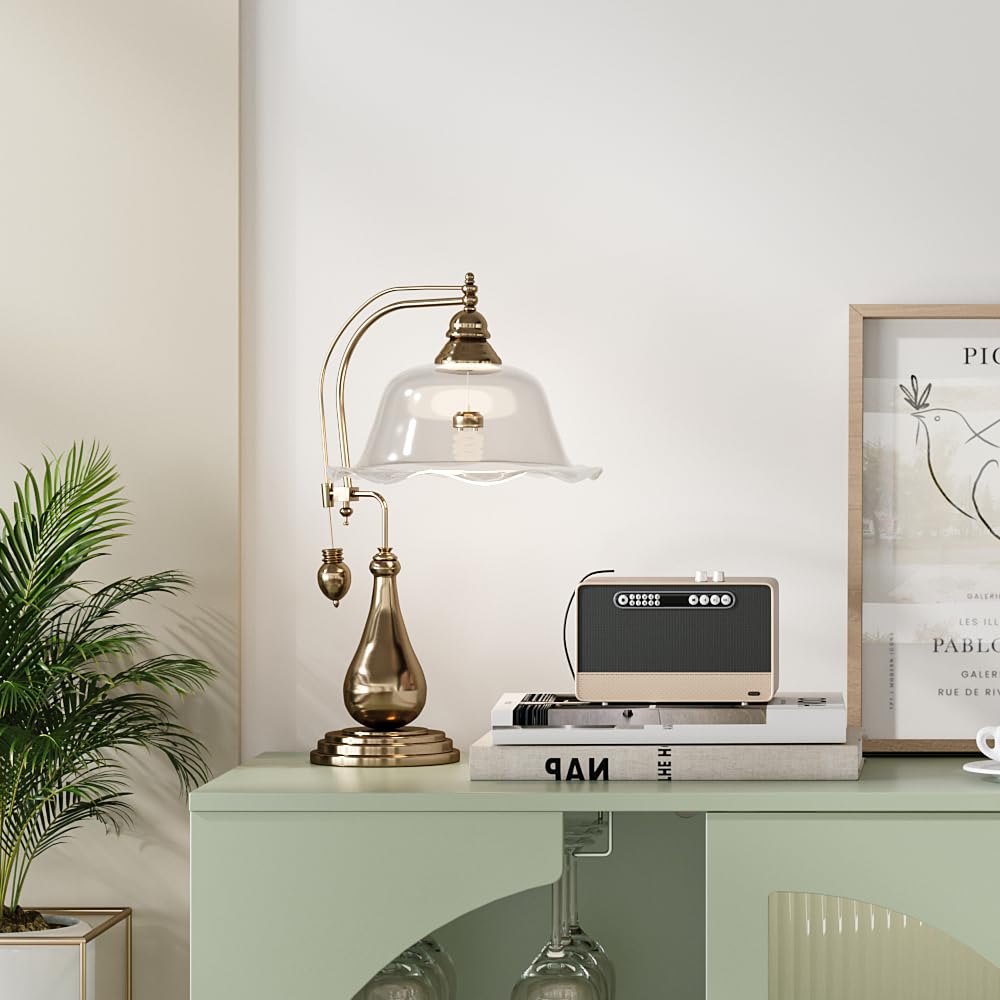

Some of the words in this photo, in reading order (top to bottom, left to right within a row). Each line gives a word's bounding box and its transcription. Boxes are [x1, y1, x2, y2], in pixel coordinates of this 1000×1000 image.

[959, 618, 979, 626] LES
[937, 688, 960, 697] RUE
[965, 688, 980, 697] DE
